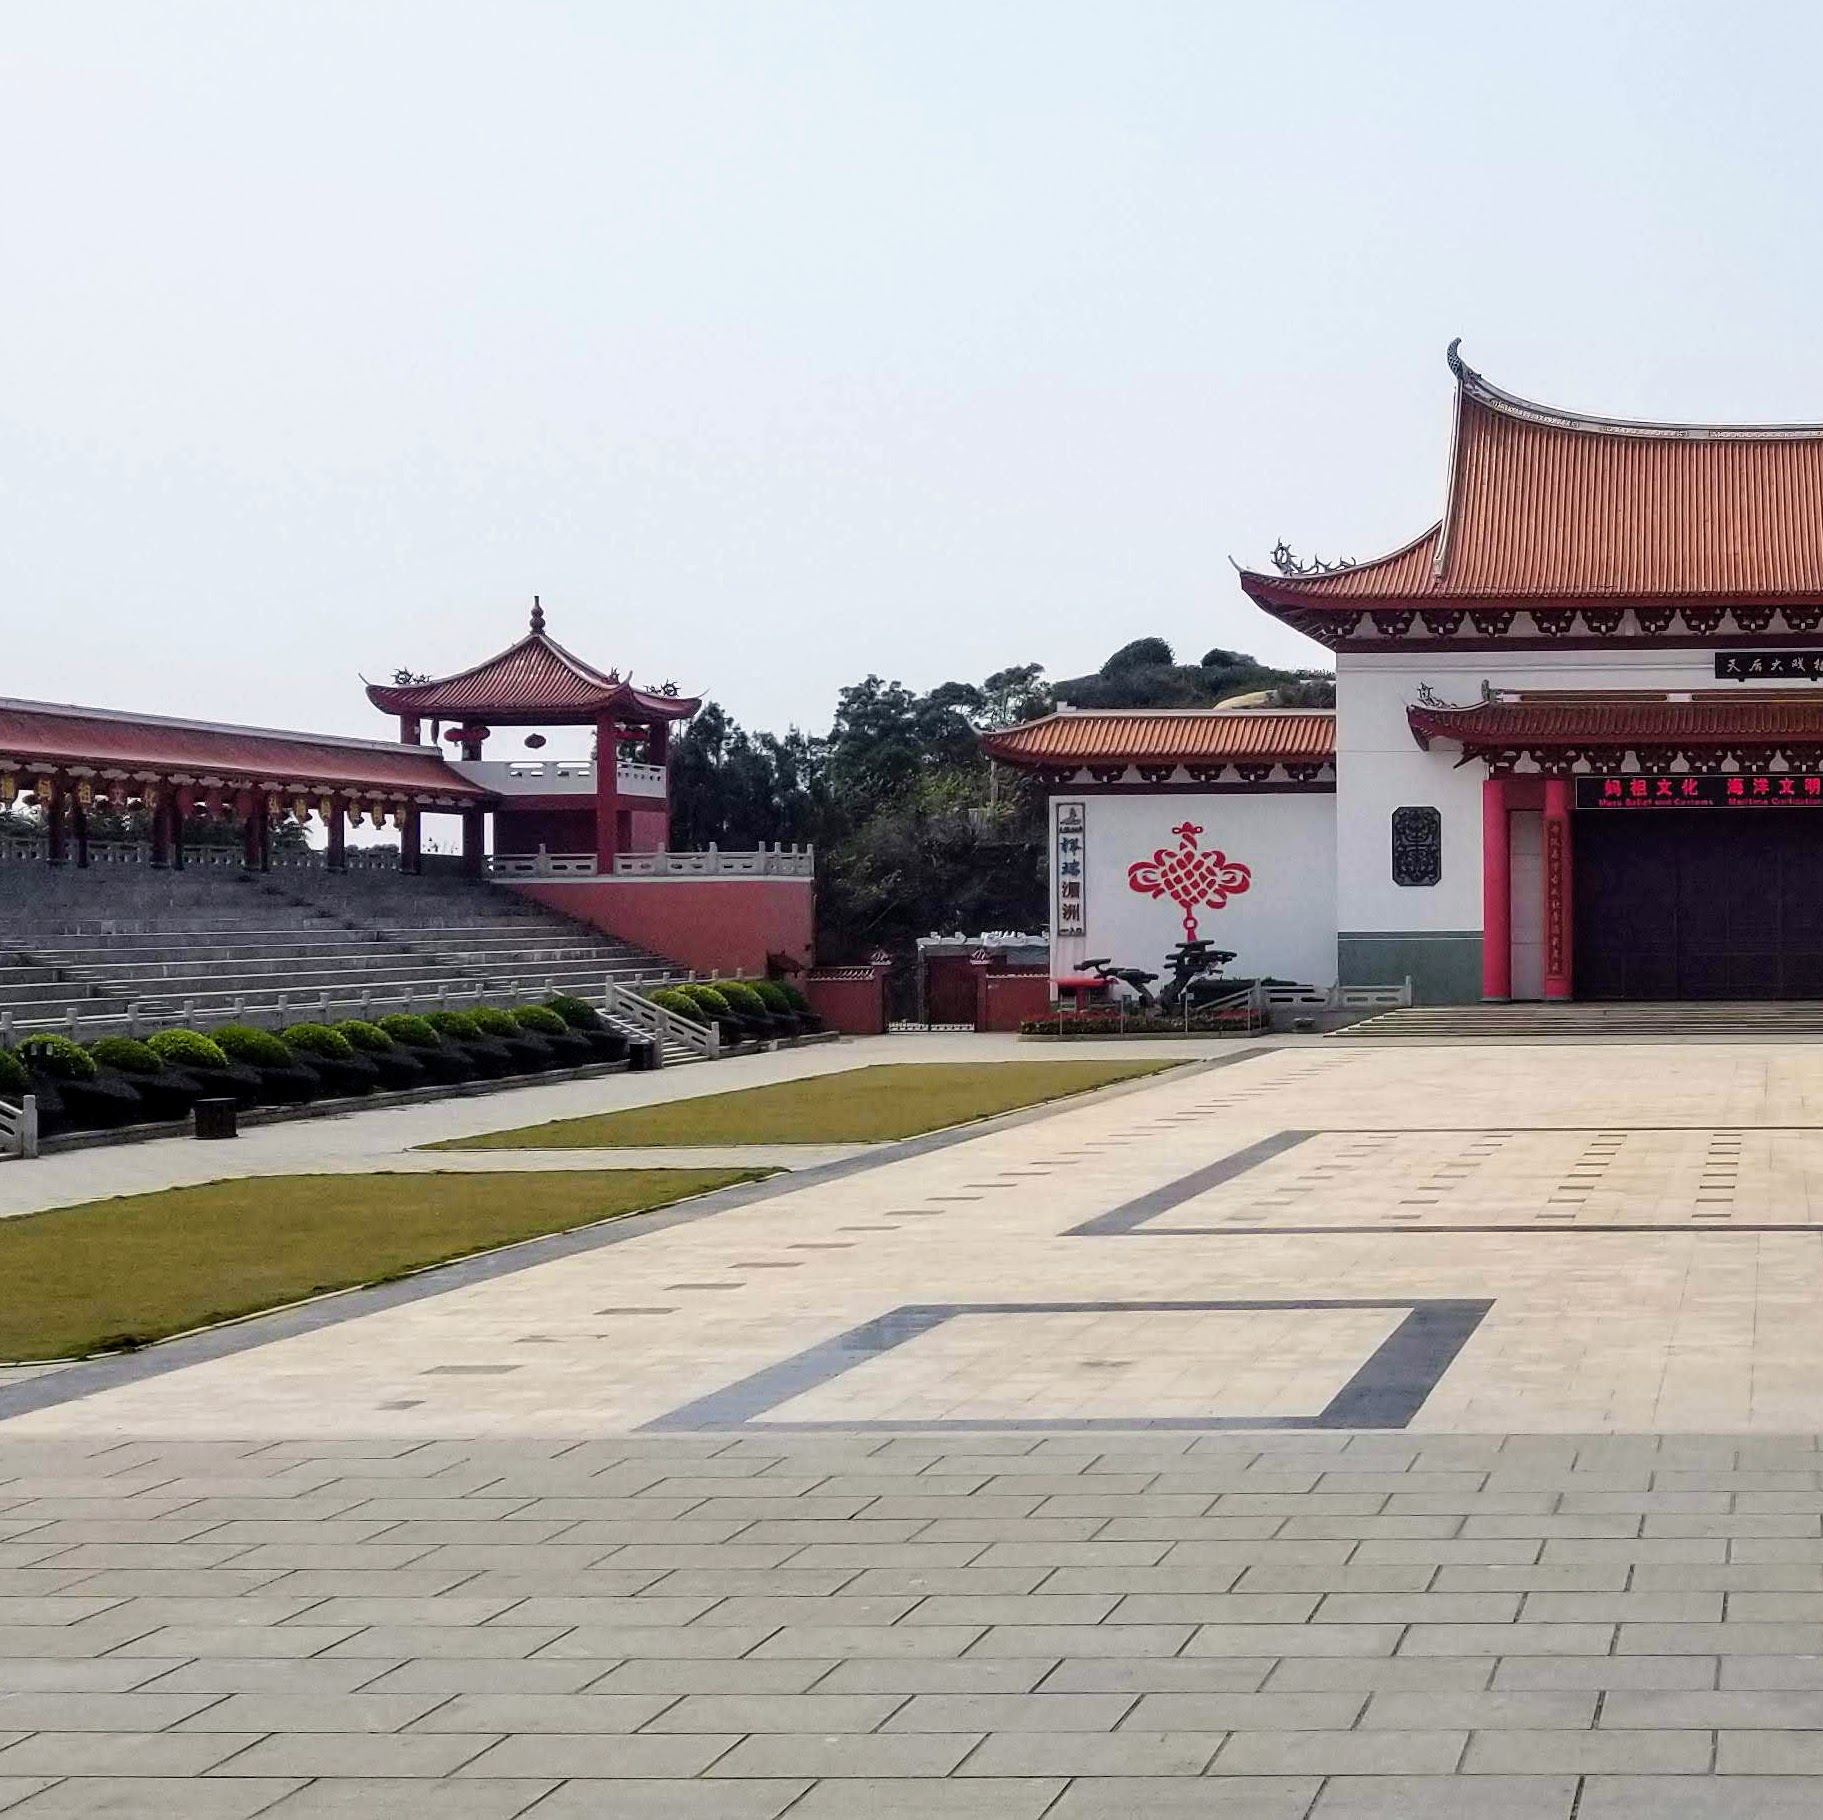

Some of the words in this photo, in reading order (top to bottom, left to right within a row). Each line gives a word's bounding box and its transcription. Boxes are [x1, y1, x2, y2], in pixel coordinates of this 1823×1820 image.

[1604, 778, 1699, 797] 妈祖文化
[1726, 777, 1821, 796] 海洋文明
